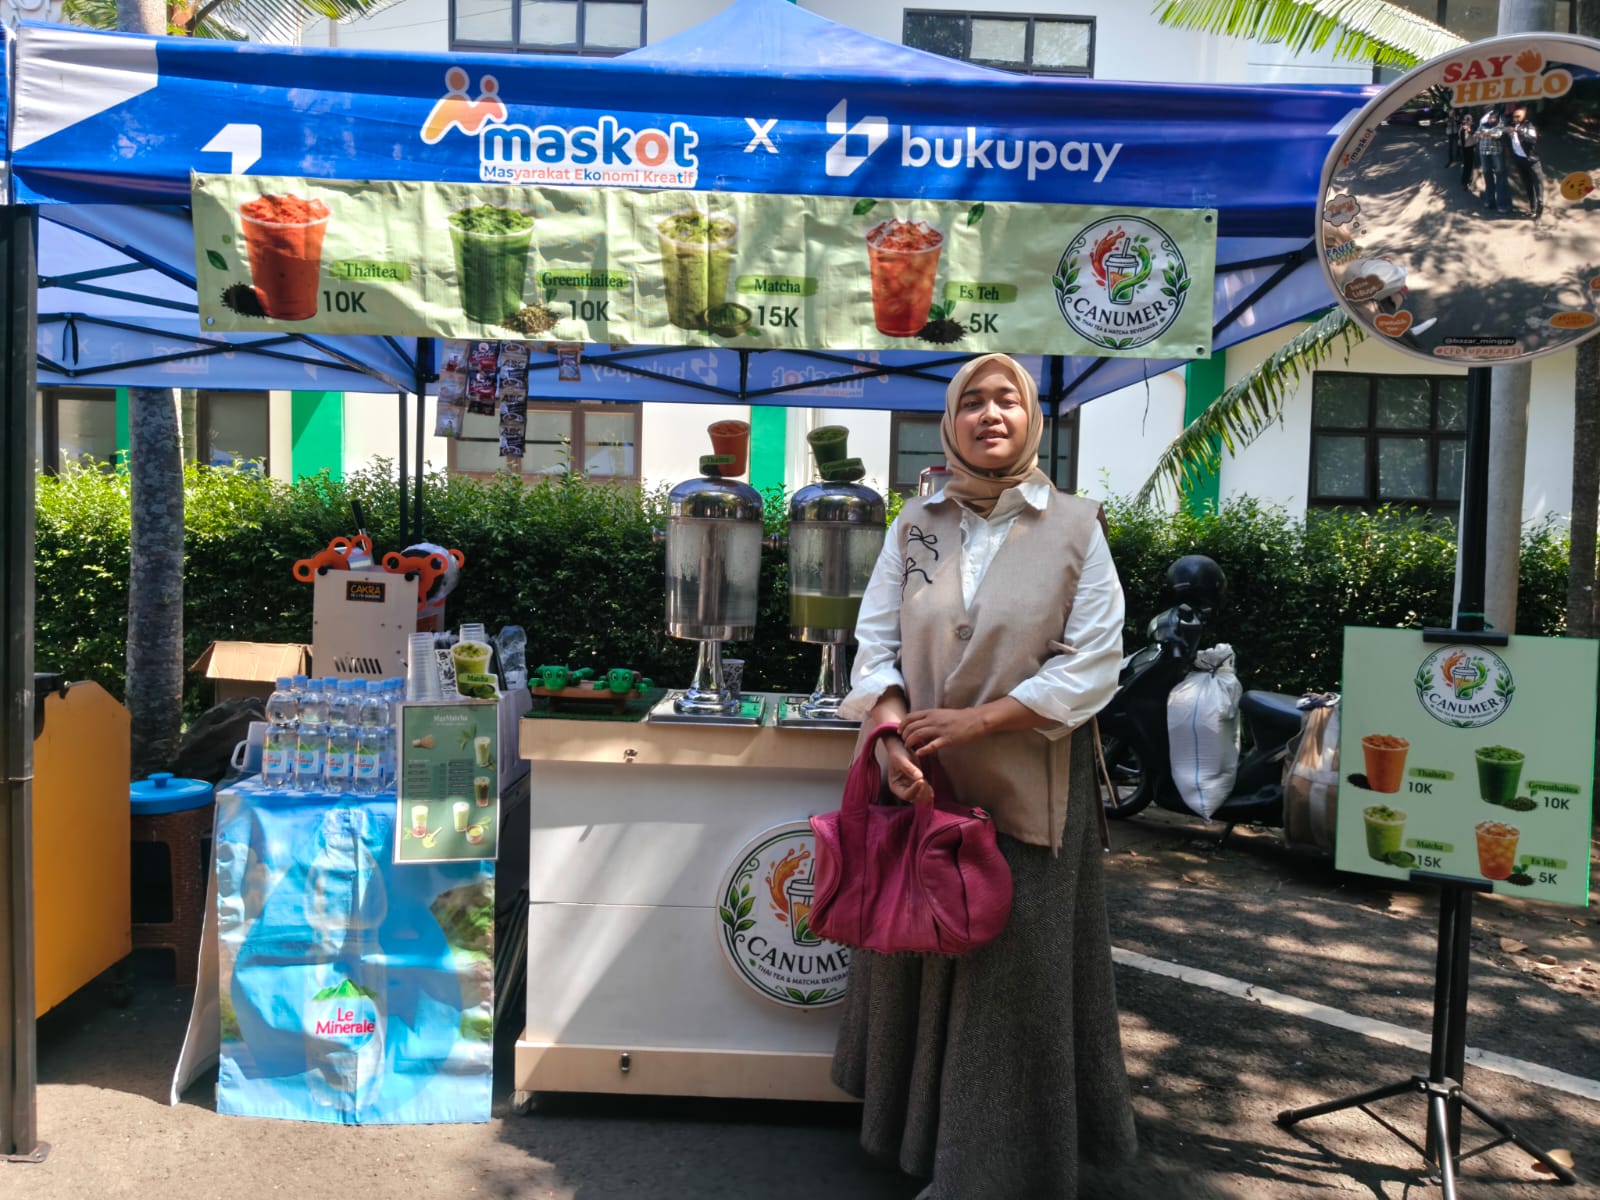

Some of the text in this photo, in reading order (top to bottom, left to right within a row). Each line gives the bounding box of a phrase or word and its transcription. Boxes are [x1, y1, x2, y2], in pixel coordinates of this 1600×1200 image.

[1443, 55, 1512, 83] SAY
[1455, 72, 1569, 104] HELLO
[482, 118, 696, 168] maskot
[902, 125, 1123, 182] bukupay
[484, 165, 694, 184] Masyarakat Ekonomi Kreatif
[344, 262, 397, 278] Thaitea
[542, 271, 623, 288] Greenthaitea
[754, 278, 801, 293] Matcha
[960, 285, 1000, 300] Es Teh
[323, 290, 367, 313] 10K
[569, 300, 610, 322] 10K
[758, 305, 799, 328] 15K
[1073, 298, 1168, 326] CANUMER
[969, 312, 999, 333] 5K
[1429, 693, 1500, 714] CANUMER
[1408, 781, 1433, 794] 10K
[1544, 796, 1570, 810] 10K
[1417, 854, 1441, 869] 15K
[1538, 872, 1558, 884] 5K
[747, 936, 851, 974] CANUME
[758, 964, 773, 977] THAI
[773, 973, 785, 981] TEA
[821, 971, 849, 984] BEVERA
[337, 1007, 354, 1021] Le
[315, 1019, 375, 1034] Minerale
